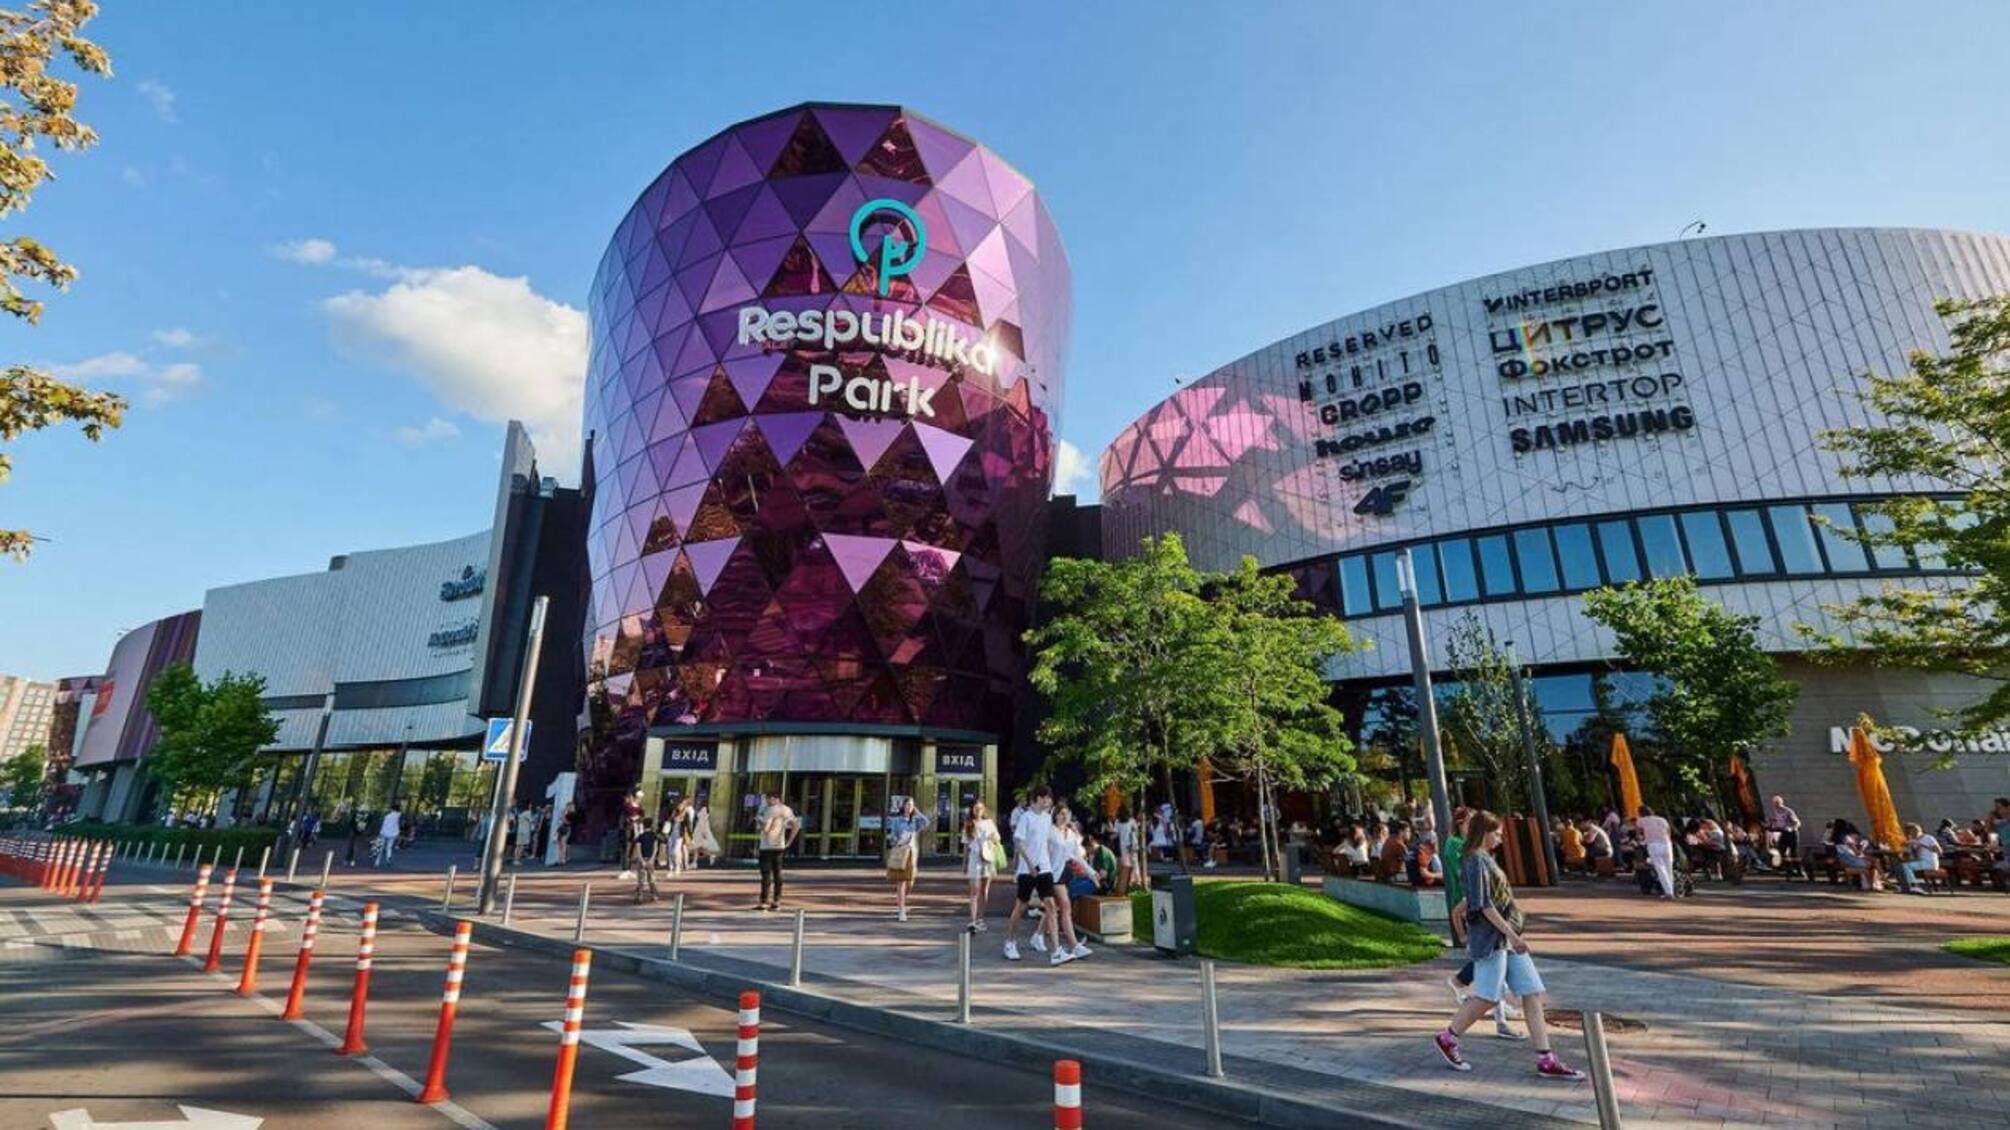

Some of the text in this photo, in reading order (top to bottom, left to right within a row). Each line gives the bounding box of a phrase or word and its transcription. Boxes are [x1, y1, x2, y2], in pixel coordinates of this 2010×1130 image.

[738, 306, 998, 376] Respublika
[1295, 314, 1434, 369] RESERVED
[1490, 304, 1664, 353] ЦИТРУС
[809, 365, 936, 418] Park
[1320, 382, 1423, 426] CROPP
[1503, 373, 1682, 417] INTERTOP
[1510, 406, 1695, 453] SAMSUNG
[1340, 450, 1422, 481] sinsay
[1353, 480, 1411, 516] 4F
[671, 749, 709, 763] ВХІД
